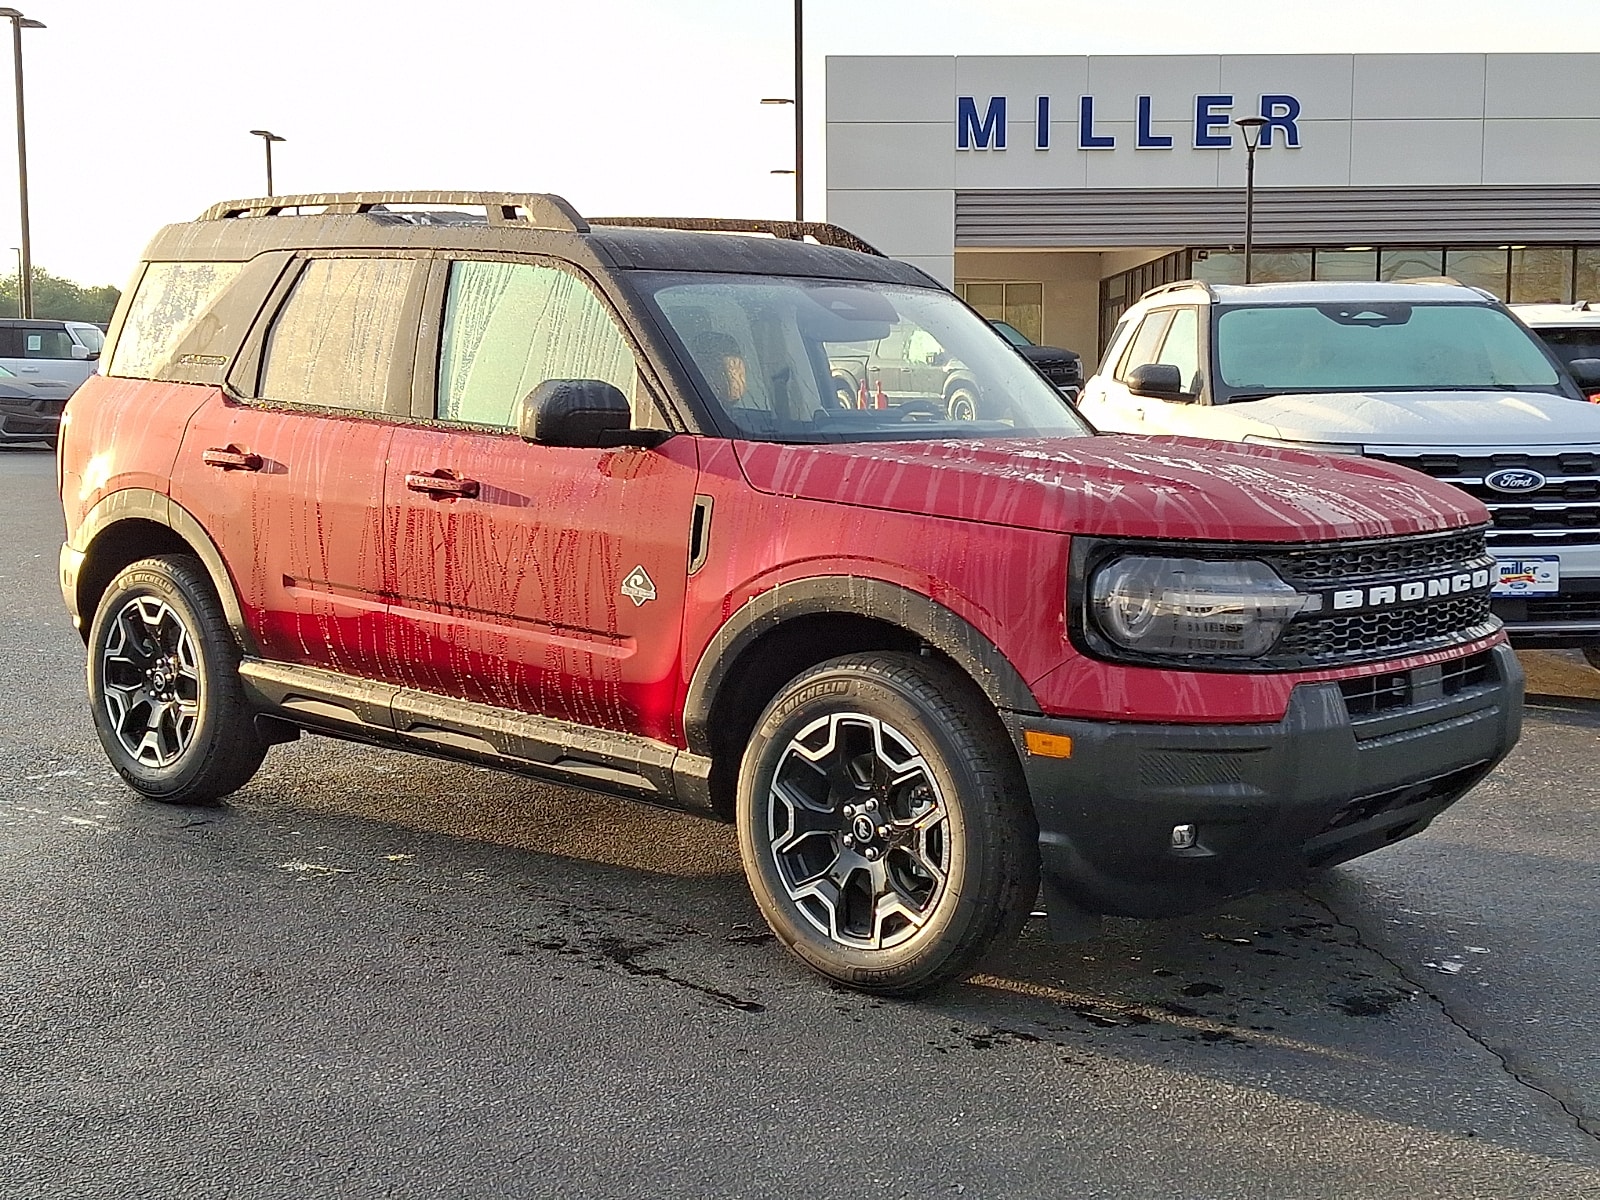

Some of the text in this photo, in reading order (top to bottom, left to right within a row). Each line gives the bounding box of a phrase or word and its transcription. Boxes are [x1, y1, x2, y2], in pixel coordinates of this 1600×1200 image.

[956, 94, 1302, 150] MILLER
[1500, 473, 1533, 487] Ford
[1500, 561, 1539, 575] miller
[135, 573, 174, 593] MICHELIN
[1333, 569, 1489, 610] BRONCO
[784, 681, 848, 714] MICHELIN
